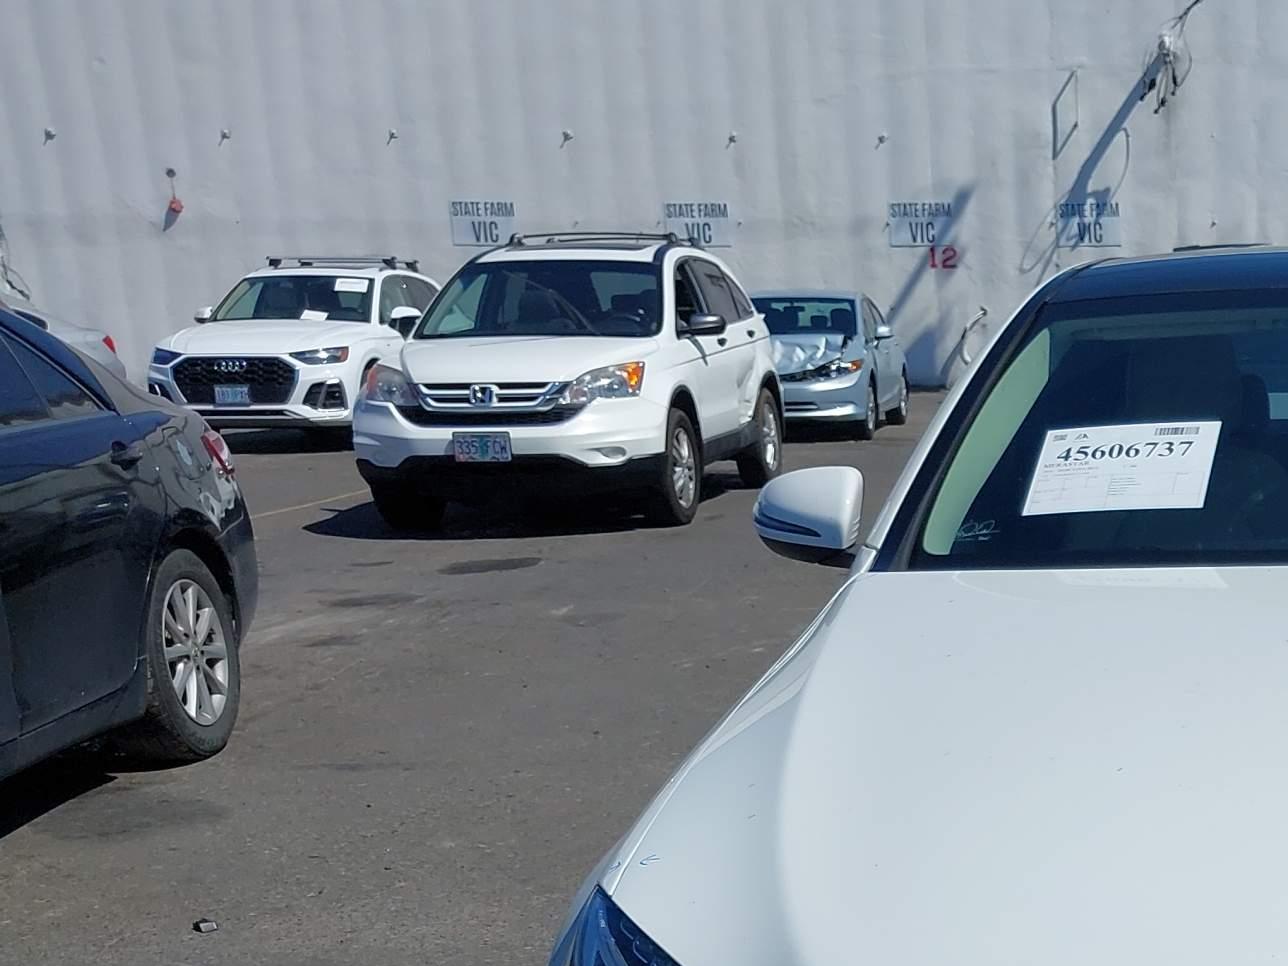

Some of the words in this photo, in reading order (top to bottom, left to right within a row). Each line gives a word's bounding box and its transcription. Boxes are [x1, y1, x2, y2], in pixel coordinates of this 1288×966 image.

[452, 202, 482, 217] STATE
[484, 202, 515, 217] FARM
[665, 203, 696, 218] STATE
[698, 203, 728, 218] FARM
[890, 203, 919, 218] STATE
[921, 203, 951, 218] FARM
[1059, 203, 1088, 218] STATE
[1089, 203, 1120, 218] FARM
[471, 221, 499, 243] VIC
[684, 222, 712, 244] VIC
[909, 222, 935, 243] VIC
[1077, 222, 1103, 243] VIC
[928, 247, 957, 269] 12
[1056, 440, 1195, 462] 45606737
